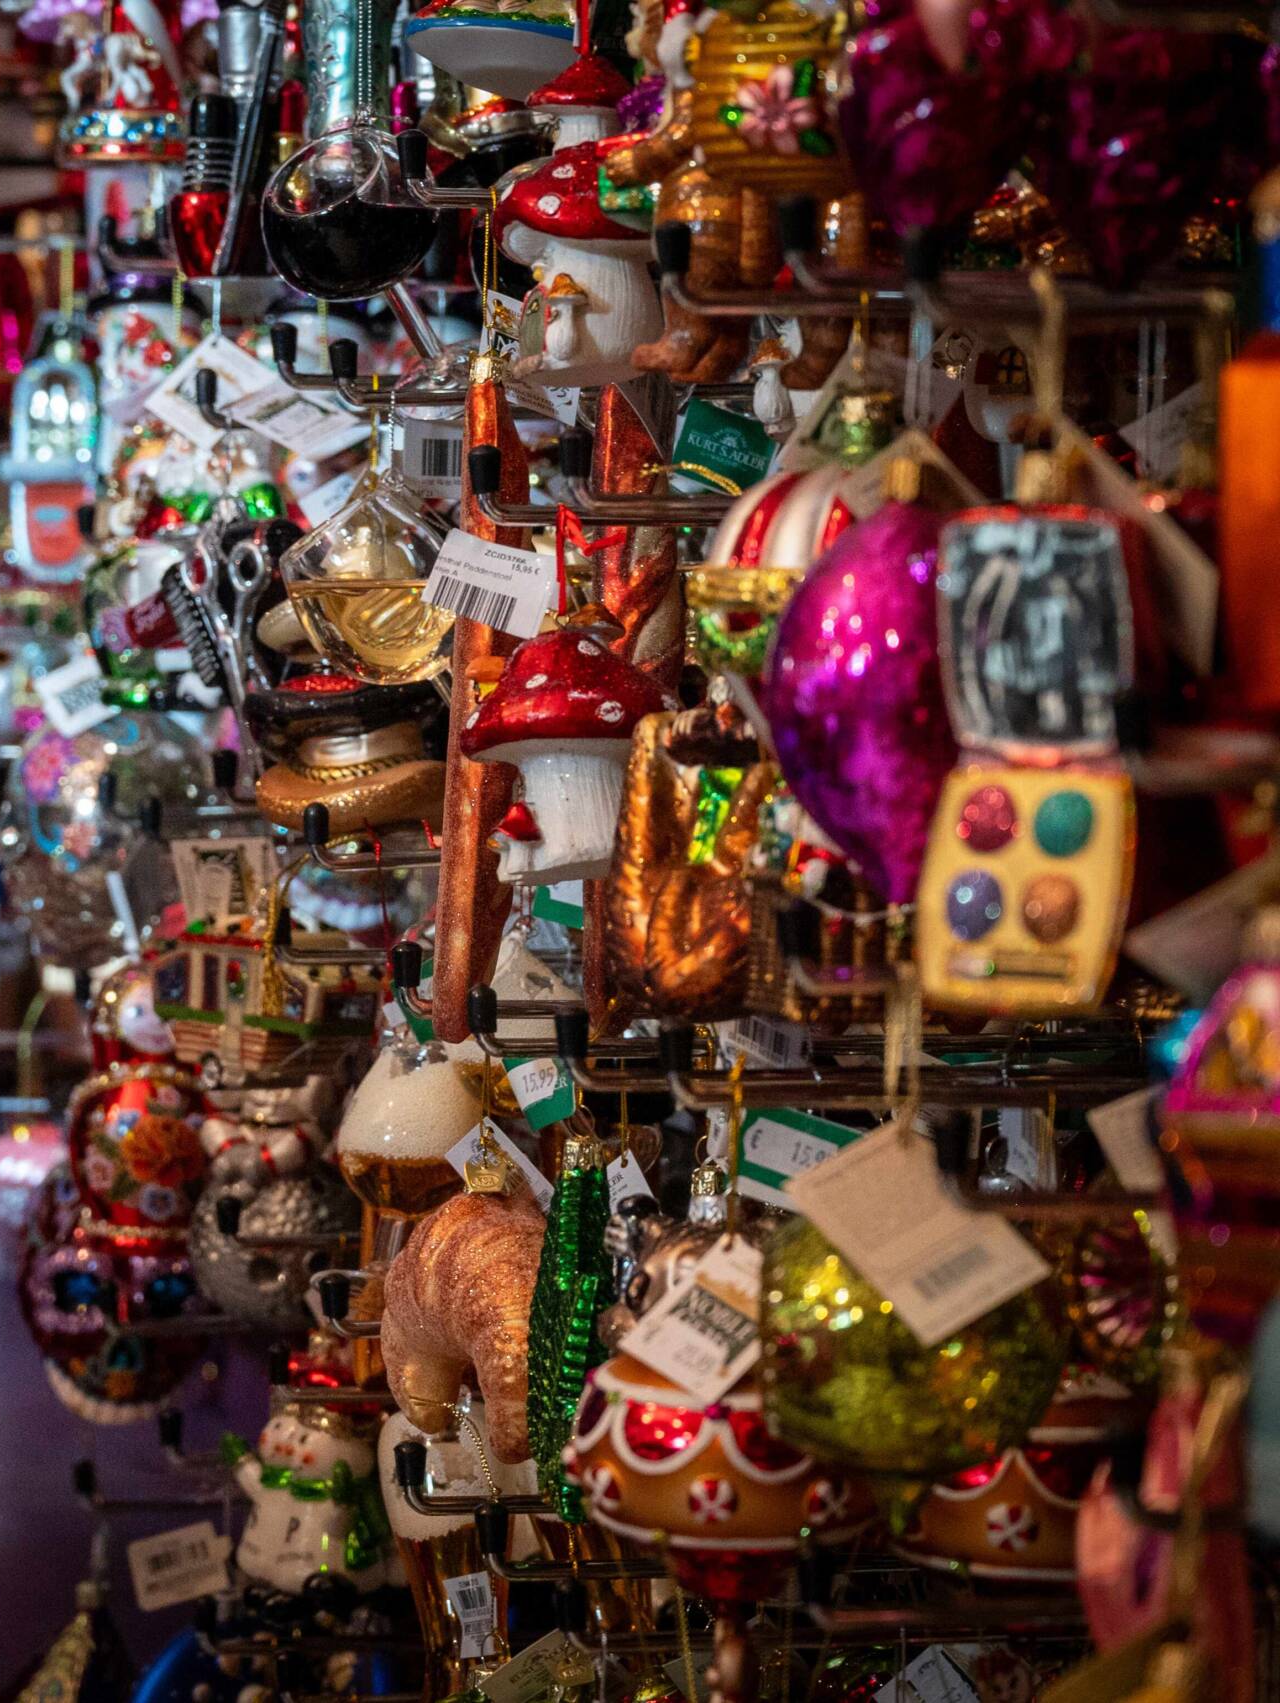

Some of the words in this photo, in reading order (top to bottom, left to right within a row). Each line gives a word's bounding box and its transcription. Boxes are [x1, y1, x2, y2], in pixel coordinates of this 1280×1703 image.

[688, 432, 718, 454] KURT
[729, 449, 766, 471] ADLER
[791, 1141, 830, 1168] 15.9
